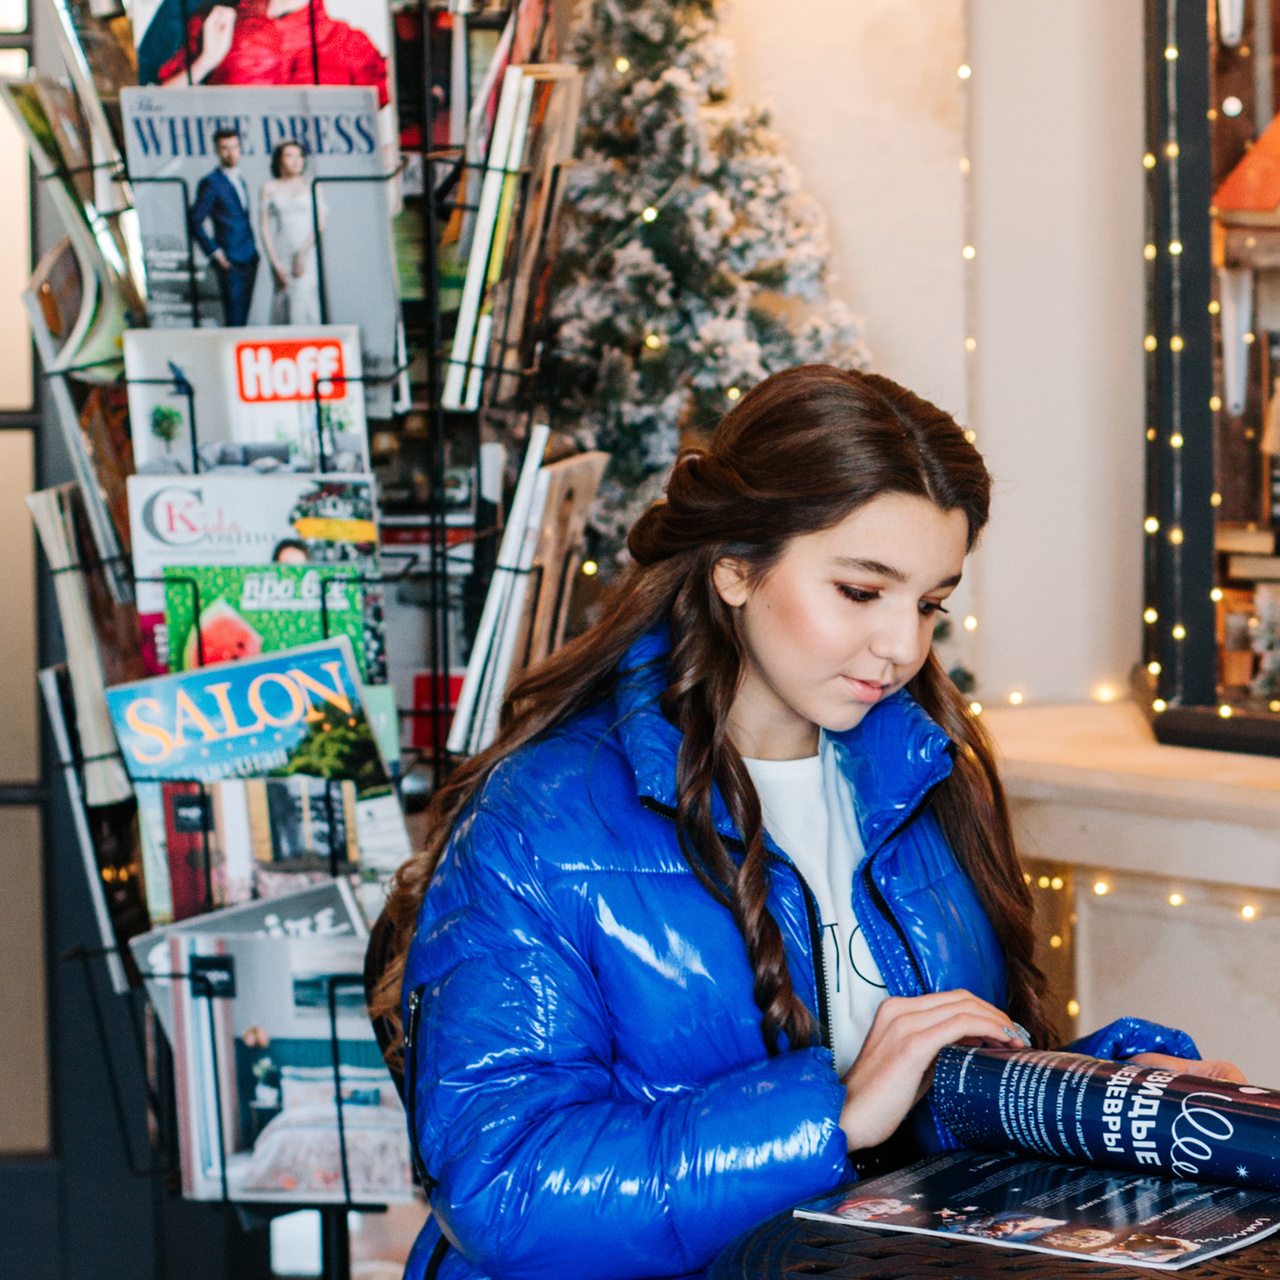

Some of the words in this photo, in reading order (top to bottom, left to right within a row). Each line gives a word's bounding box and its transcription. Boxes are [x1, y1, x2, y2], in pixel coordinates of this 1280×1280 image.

[133, 115, 253, 157] WHITE
[261, 114, 376, 155] DRESS
[240, 346, 340, 400] Hoff
[126, 661, 353, 765] SALON
[1128, 1070, 1183, 1166] ЕВИДЫЕ
